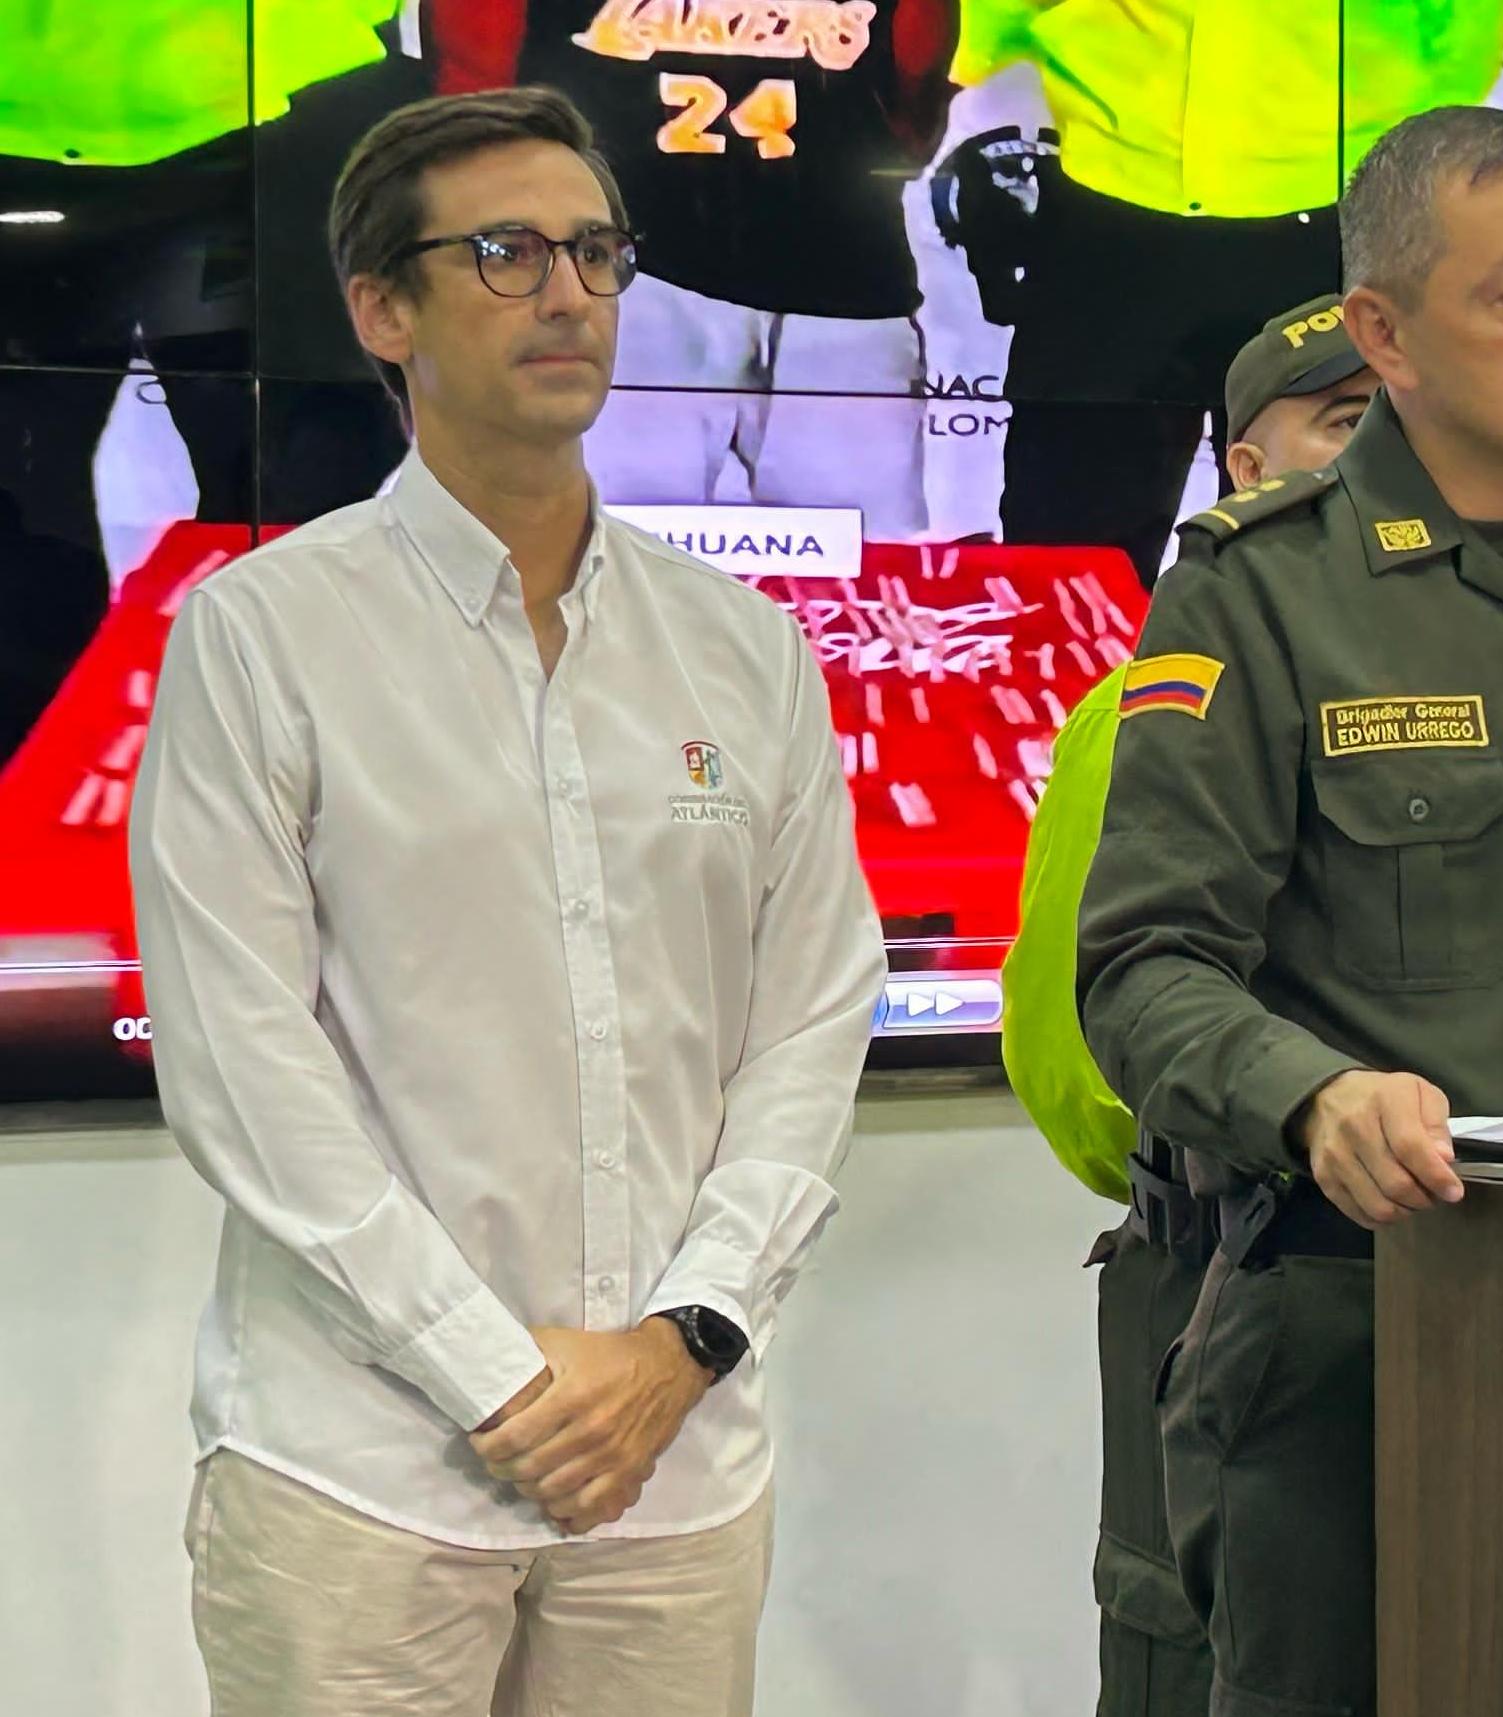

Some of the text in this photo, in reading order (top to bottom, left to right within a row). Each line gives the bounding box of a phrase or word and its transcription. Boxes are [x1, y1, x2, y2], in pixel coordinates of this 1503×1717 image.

[656, 72, 797, 159] 24
[1337, 720, 1474, 747] EDWIN URREGO
